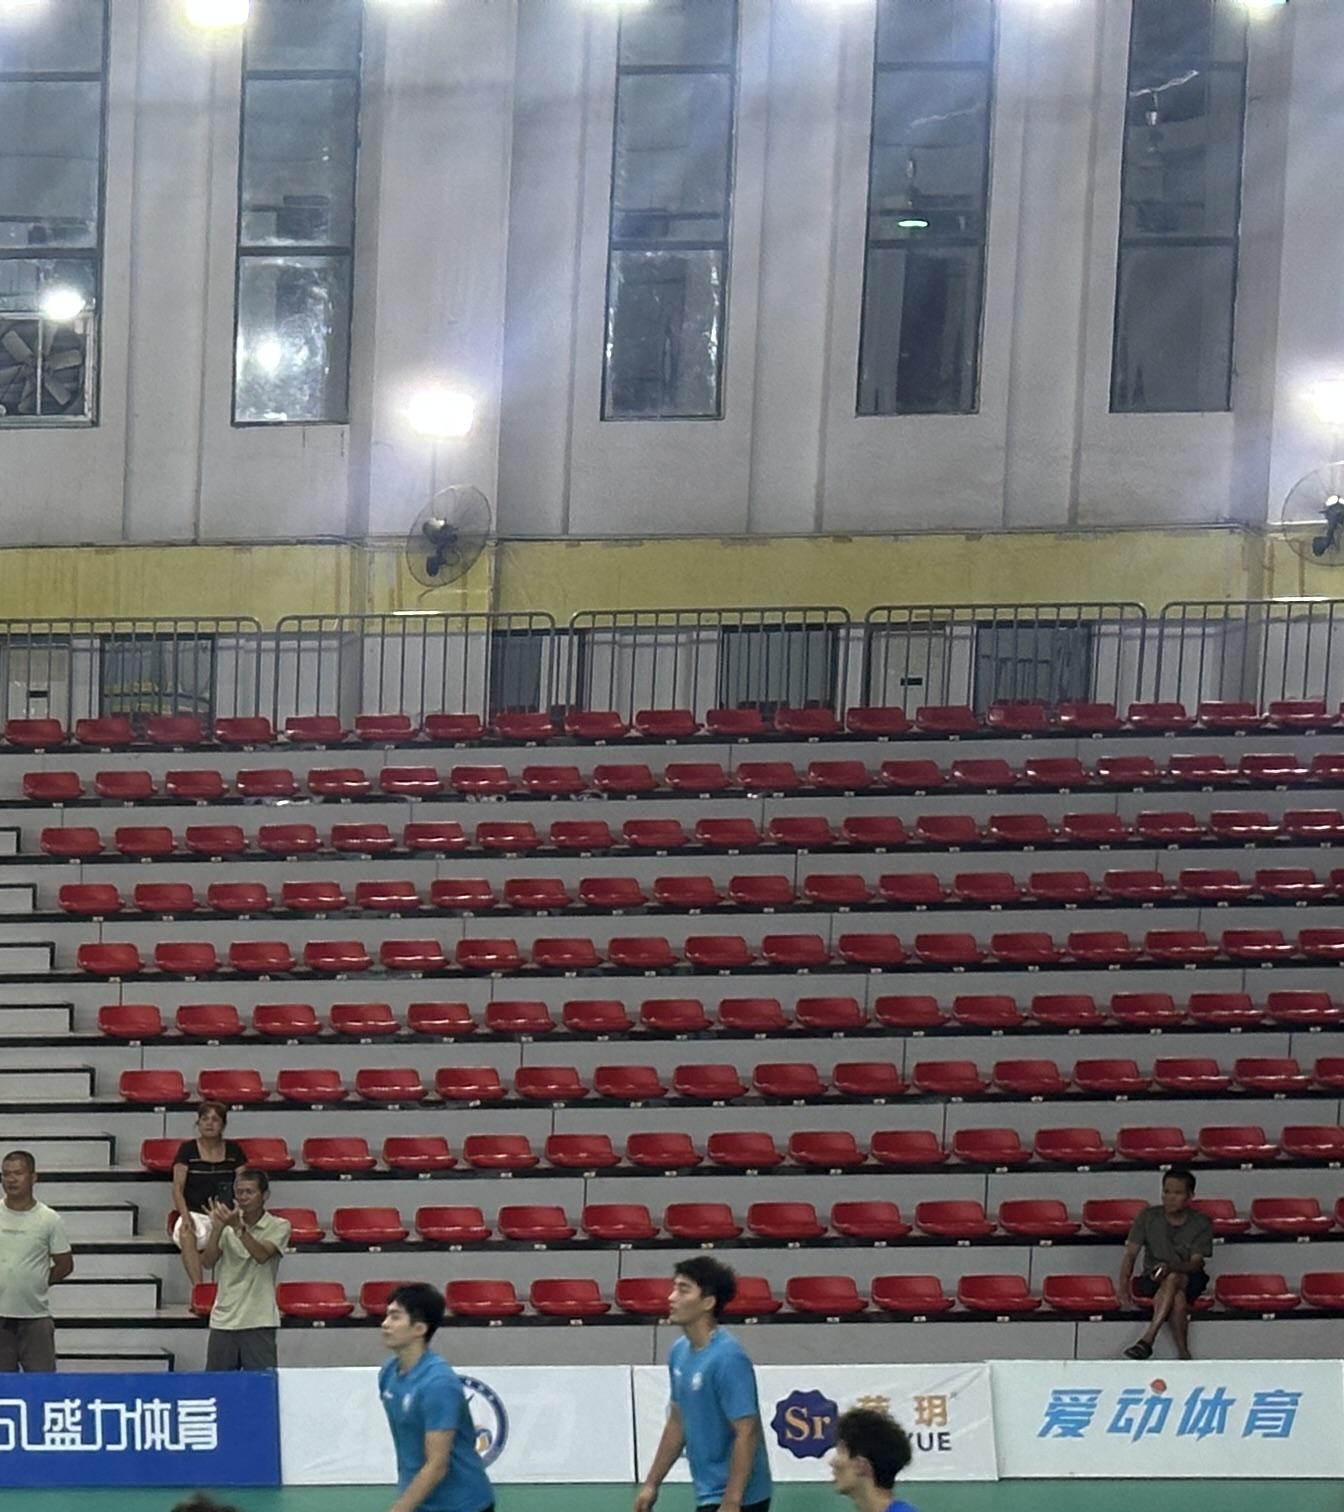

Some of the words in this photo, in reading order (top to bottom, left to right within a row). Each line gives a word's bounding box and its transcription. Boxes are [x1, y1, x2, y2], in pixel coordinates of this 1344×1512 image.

[785, 1405, 831, 1441] Sr
[1037, 1386, 1304, 1443] 爱动体育
